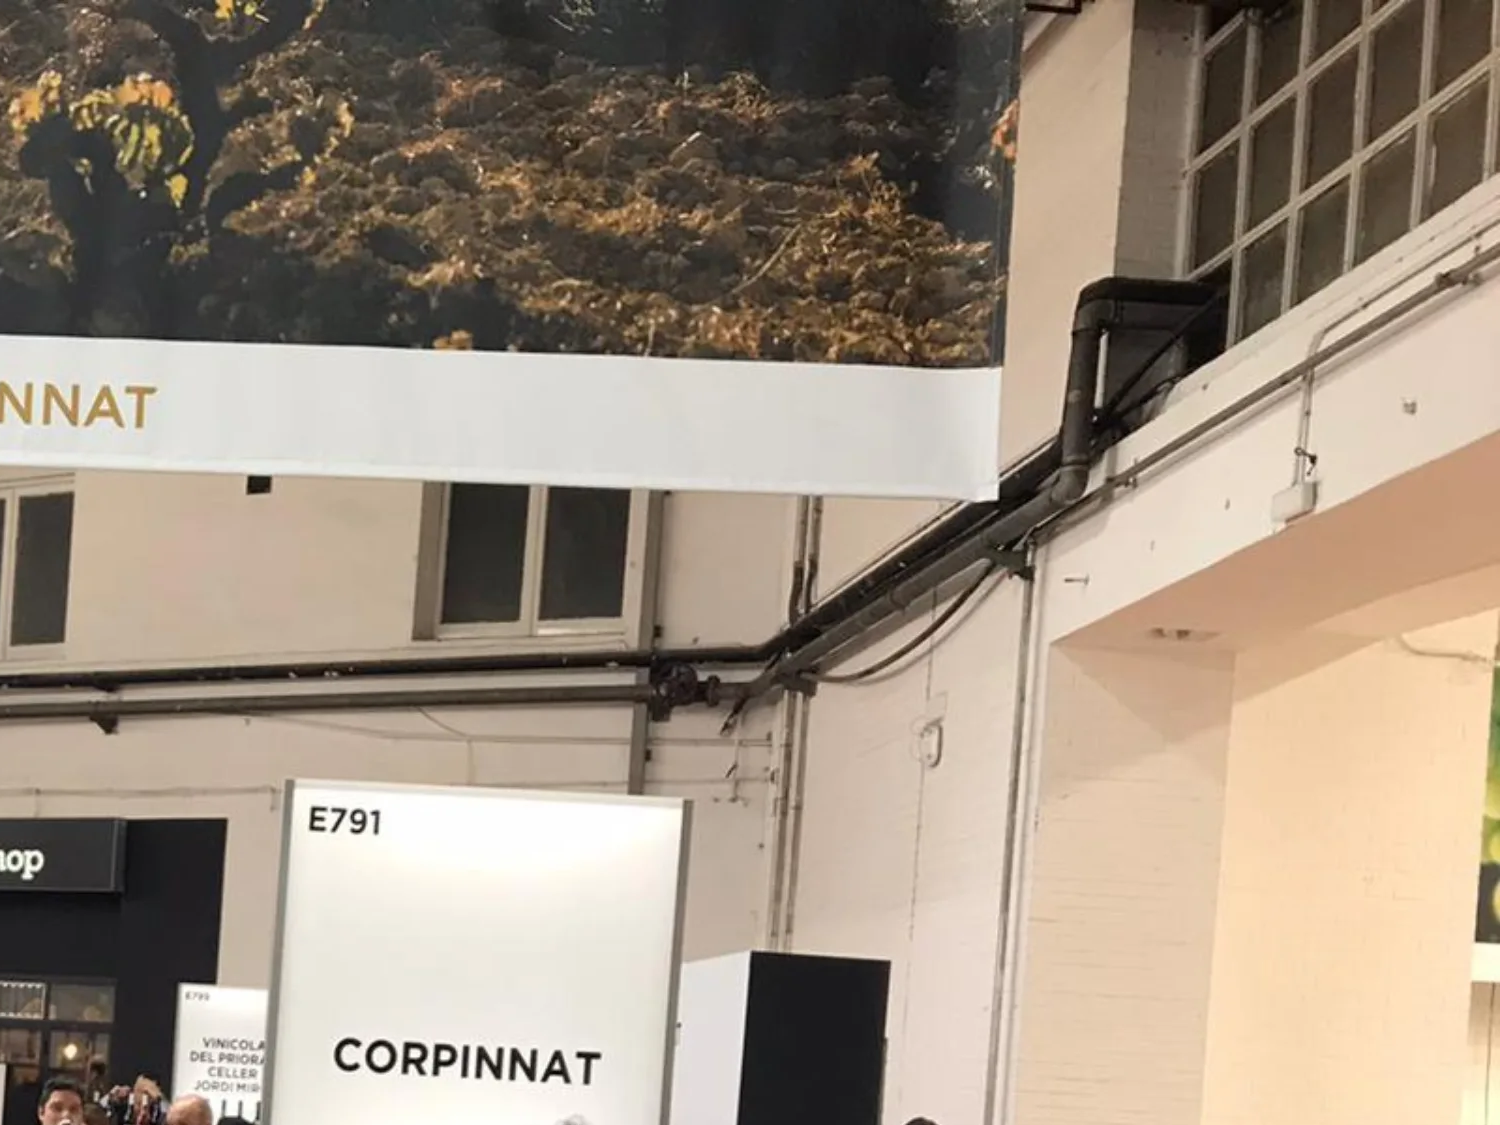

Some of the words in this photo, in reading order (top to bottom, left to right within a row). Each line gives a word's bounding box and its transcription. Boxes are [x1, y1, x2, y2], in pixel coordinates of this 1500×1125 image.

[309, 806, 382, 835] E791
[189, 1051, 215, 1063] DEL
[334, 1038, 602, 1085] CORPINNAT
[207, 1066, 258, 1079] CELLER
[194, 1080, 233, 1092] JORDI
